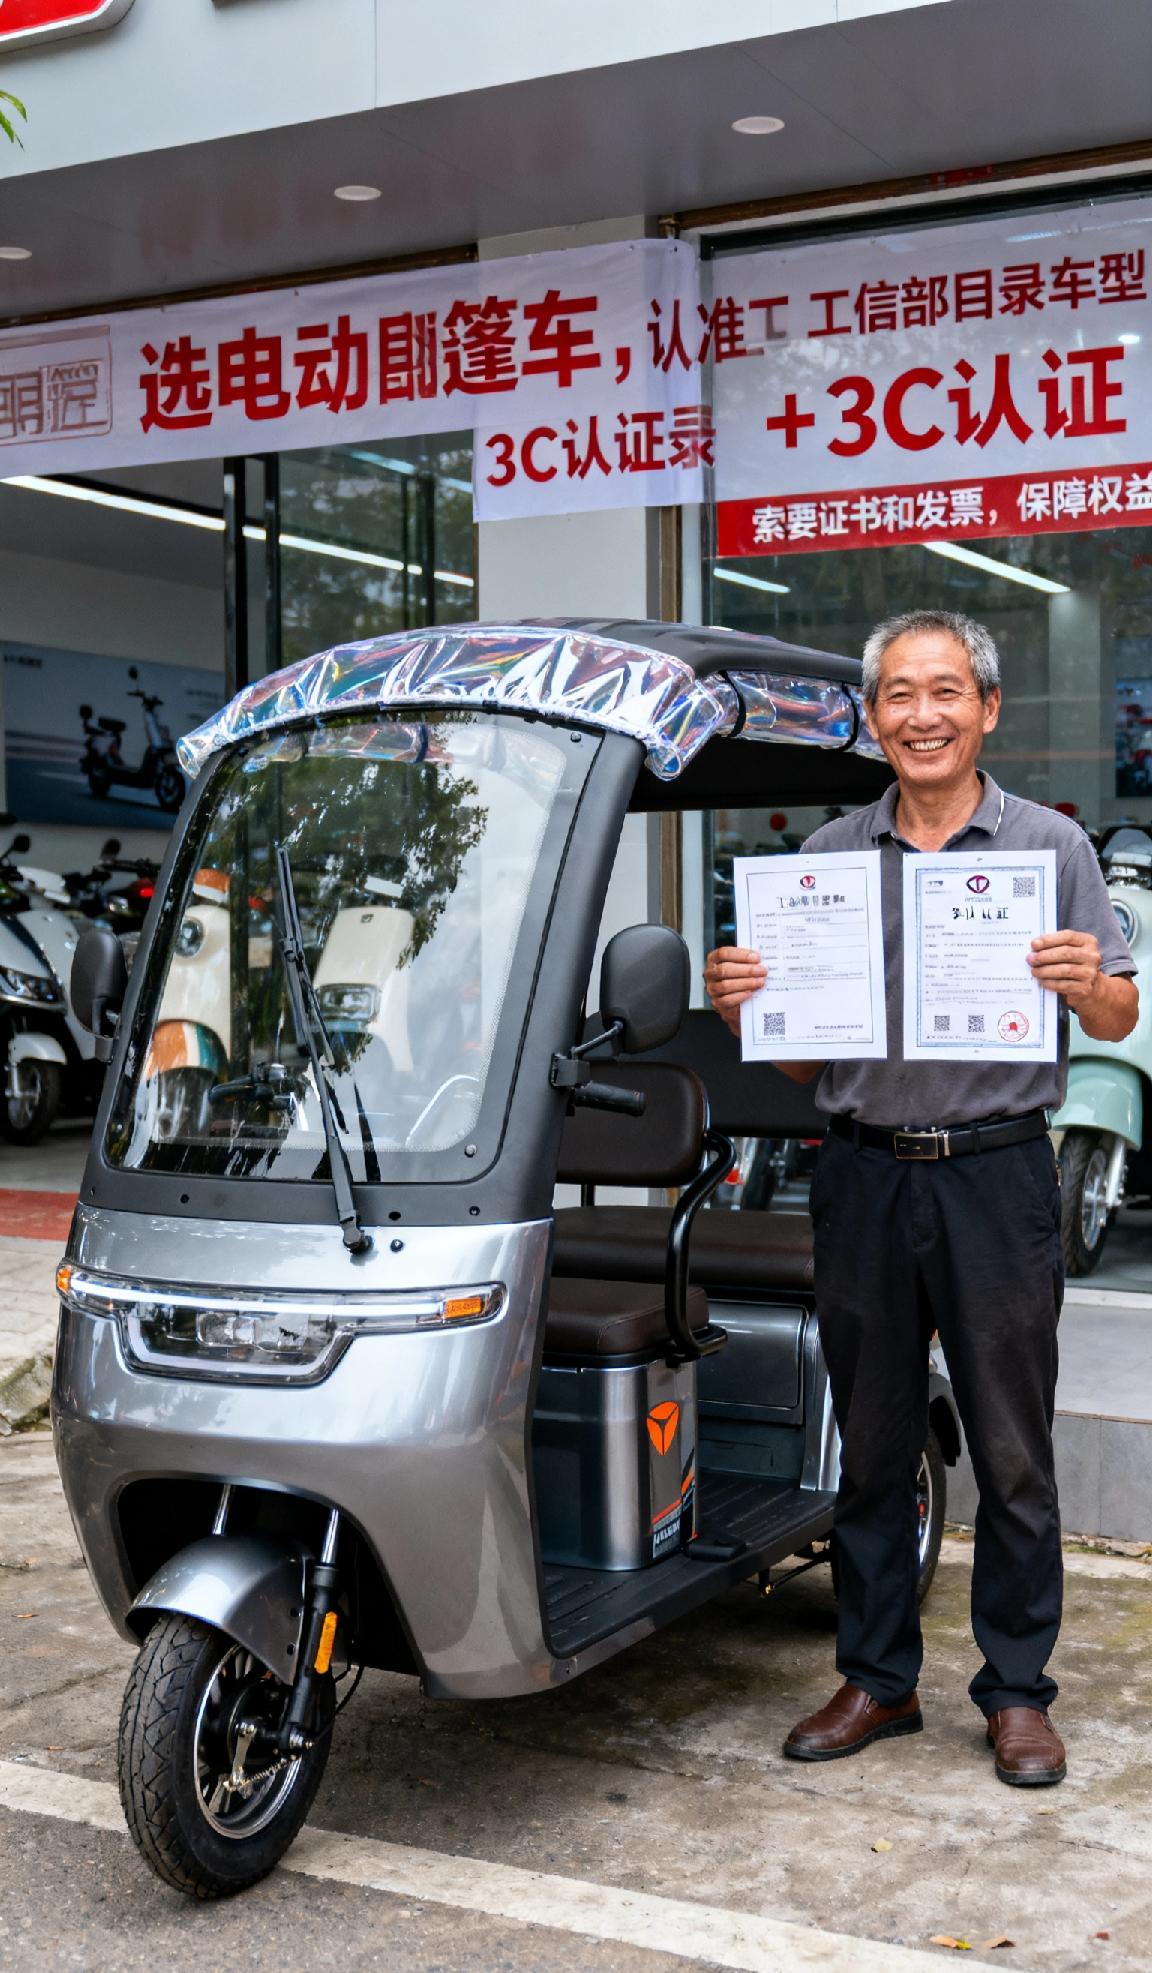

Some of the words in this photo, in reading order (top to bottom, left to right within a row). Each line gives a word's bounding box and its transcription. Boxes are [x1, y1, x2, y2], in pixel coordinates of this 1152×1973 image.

[807, 249, 1147, 338] 工信部目录车型
